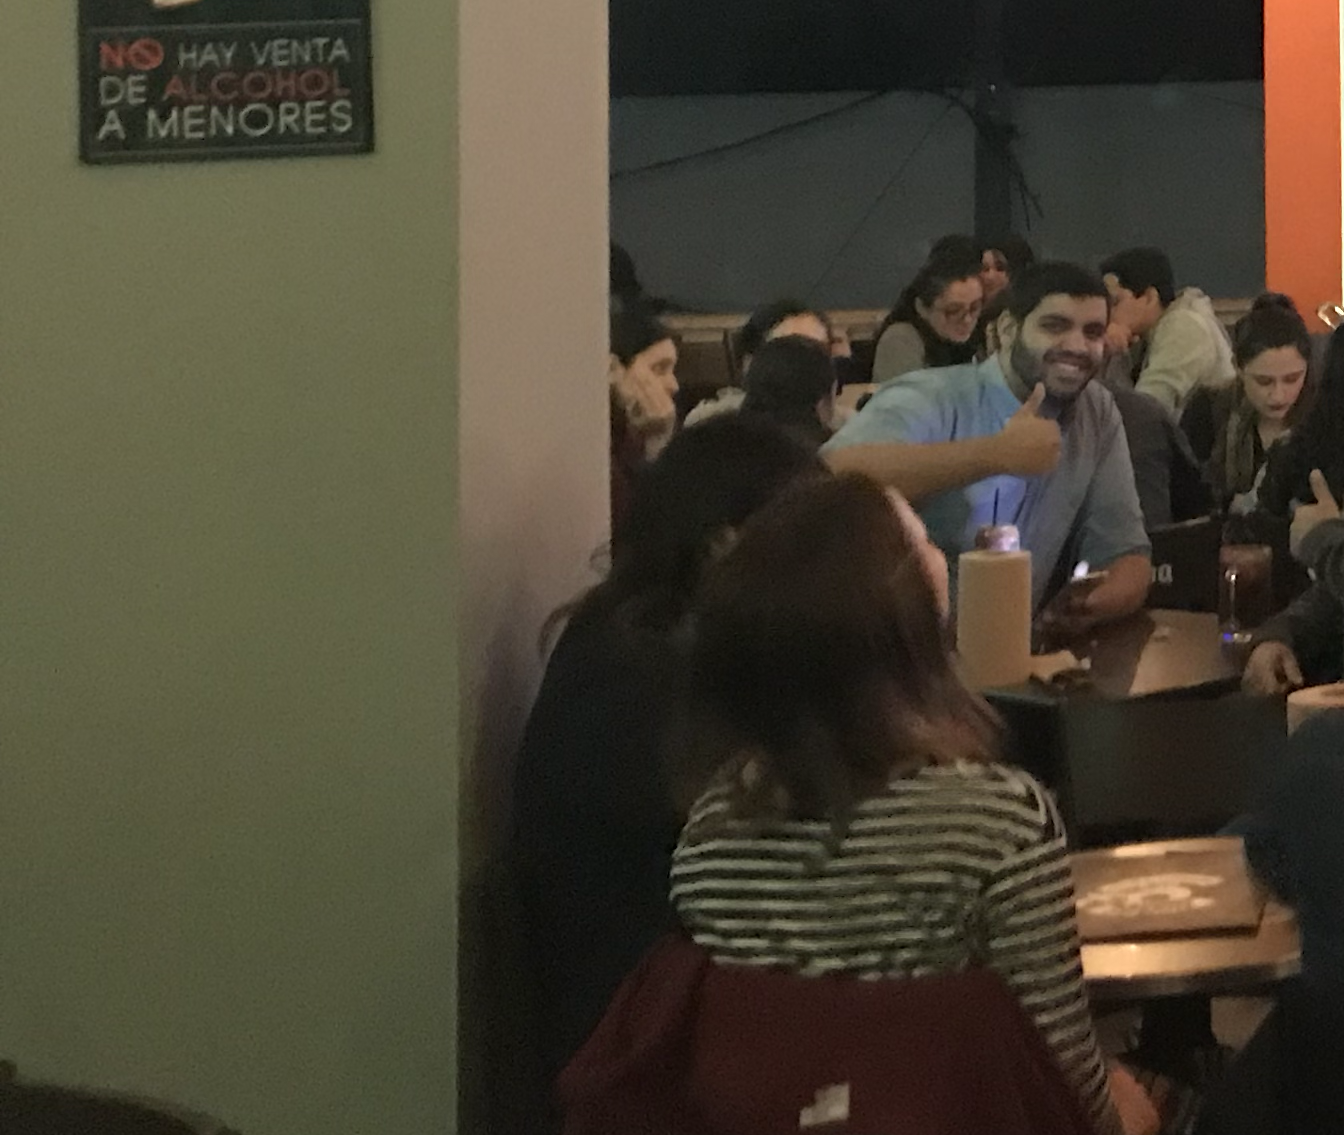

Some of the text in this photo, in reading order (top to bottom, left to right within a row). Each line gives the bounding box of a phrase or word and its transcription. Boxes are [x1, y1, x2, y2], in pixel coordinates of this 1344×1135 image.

[99, 37, 350, 71] NO HAY VENTA
[99, 68, 351, 106] DE ALCOHOL
[97, 98, 353, 140] A MENORES
